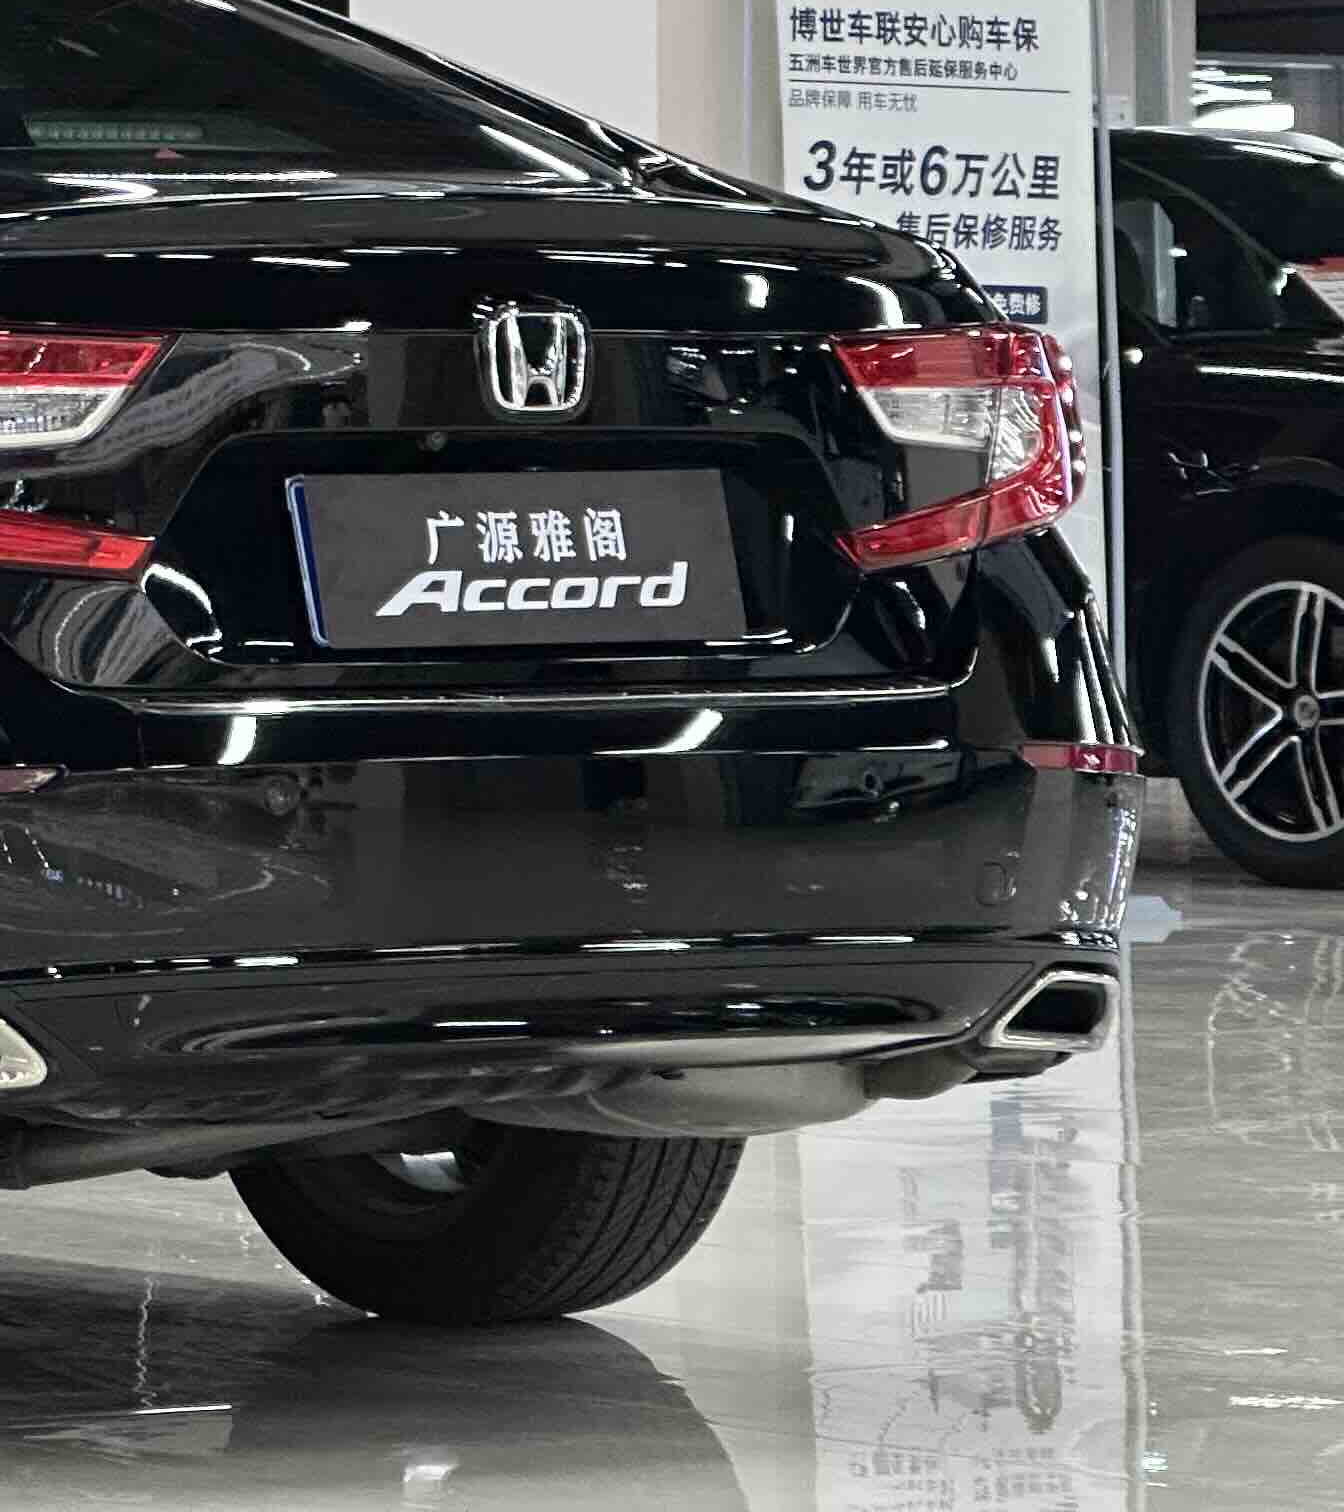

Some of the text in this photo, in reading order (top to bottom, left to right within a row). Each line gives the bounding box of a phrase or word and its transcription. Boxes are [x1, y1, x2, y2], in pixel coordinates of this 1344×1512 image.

[790, 6, 1040, 52] 博世车联安心购车保
[789, 53, 1018, 81] 五洲车世界官方售后延保服务中心
[789, 89, 918, 113] 品牌保障 用车无忧
[803, 140, 1062, 201] 3年或6万公里
[896, 210, 1063, 252] 售后保修服务
[425, 507, 628, 565] 广源雅阁
[375, 561, 689, 617] Accord
